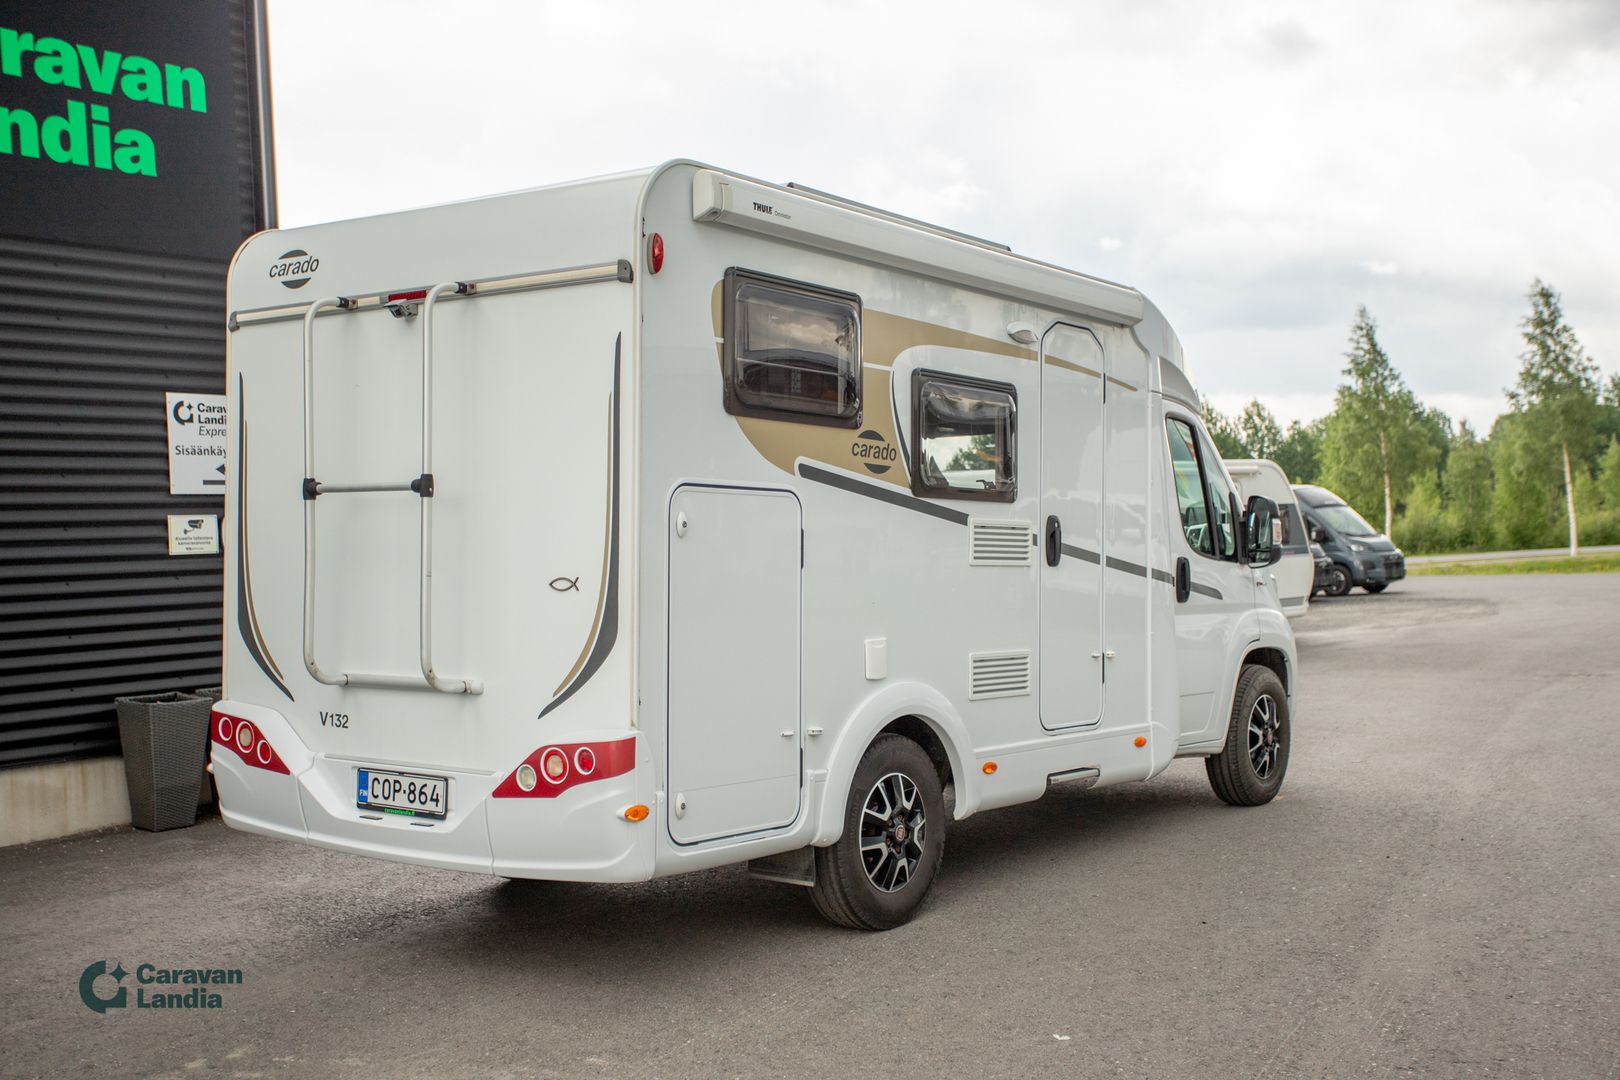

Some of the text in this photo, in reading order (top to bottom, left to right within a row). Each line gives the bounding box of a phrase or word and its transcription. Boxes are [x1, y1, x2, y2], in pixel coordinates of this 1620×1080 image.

[753, 202, 773, 215] THULE
[269, 256, 320, 278] carado
[851, 443, 897, 461] carado
[319, 711, 349, 729] V132
[371, 777, 440, 808] COP-864
